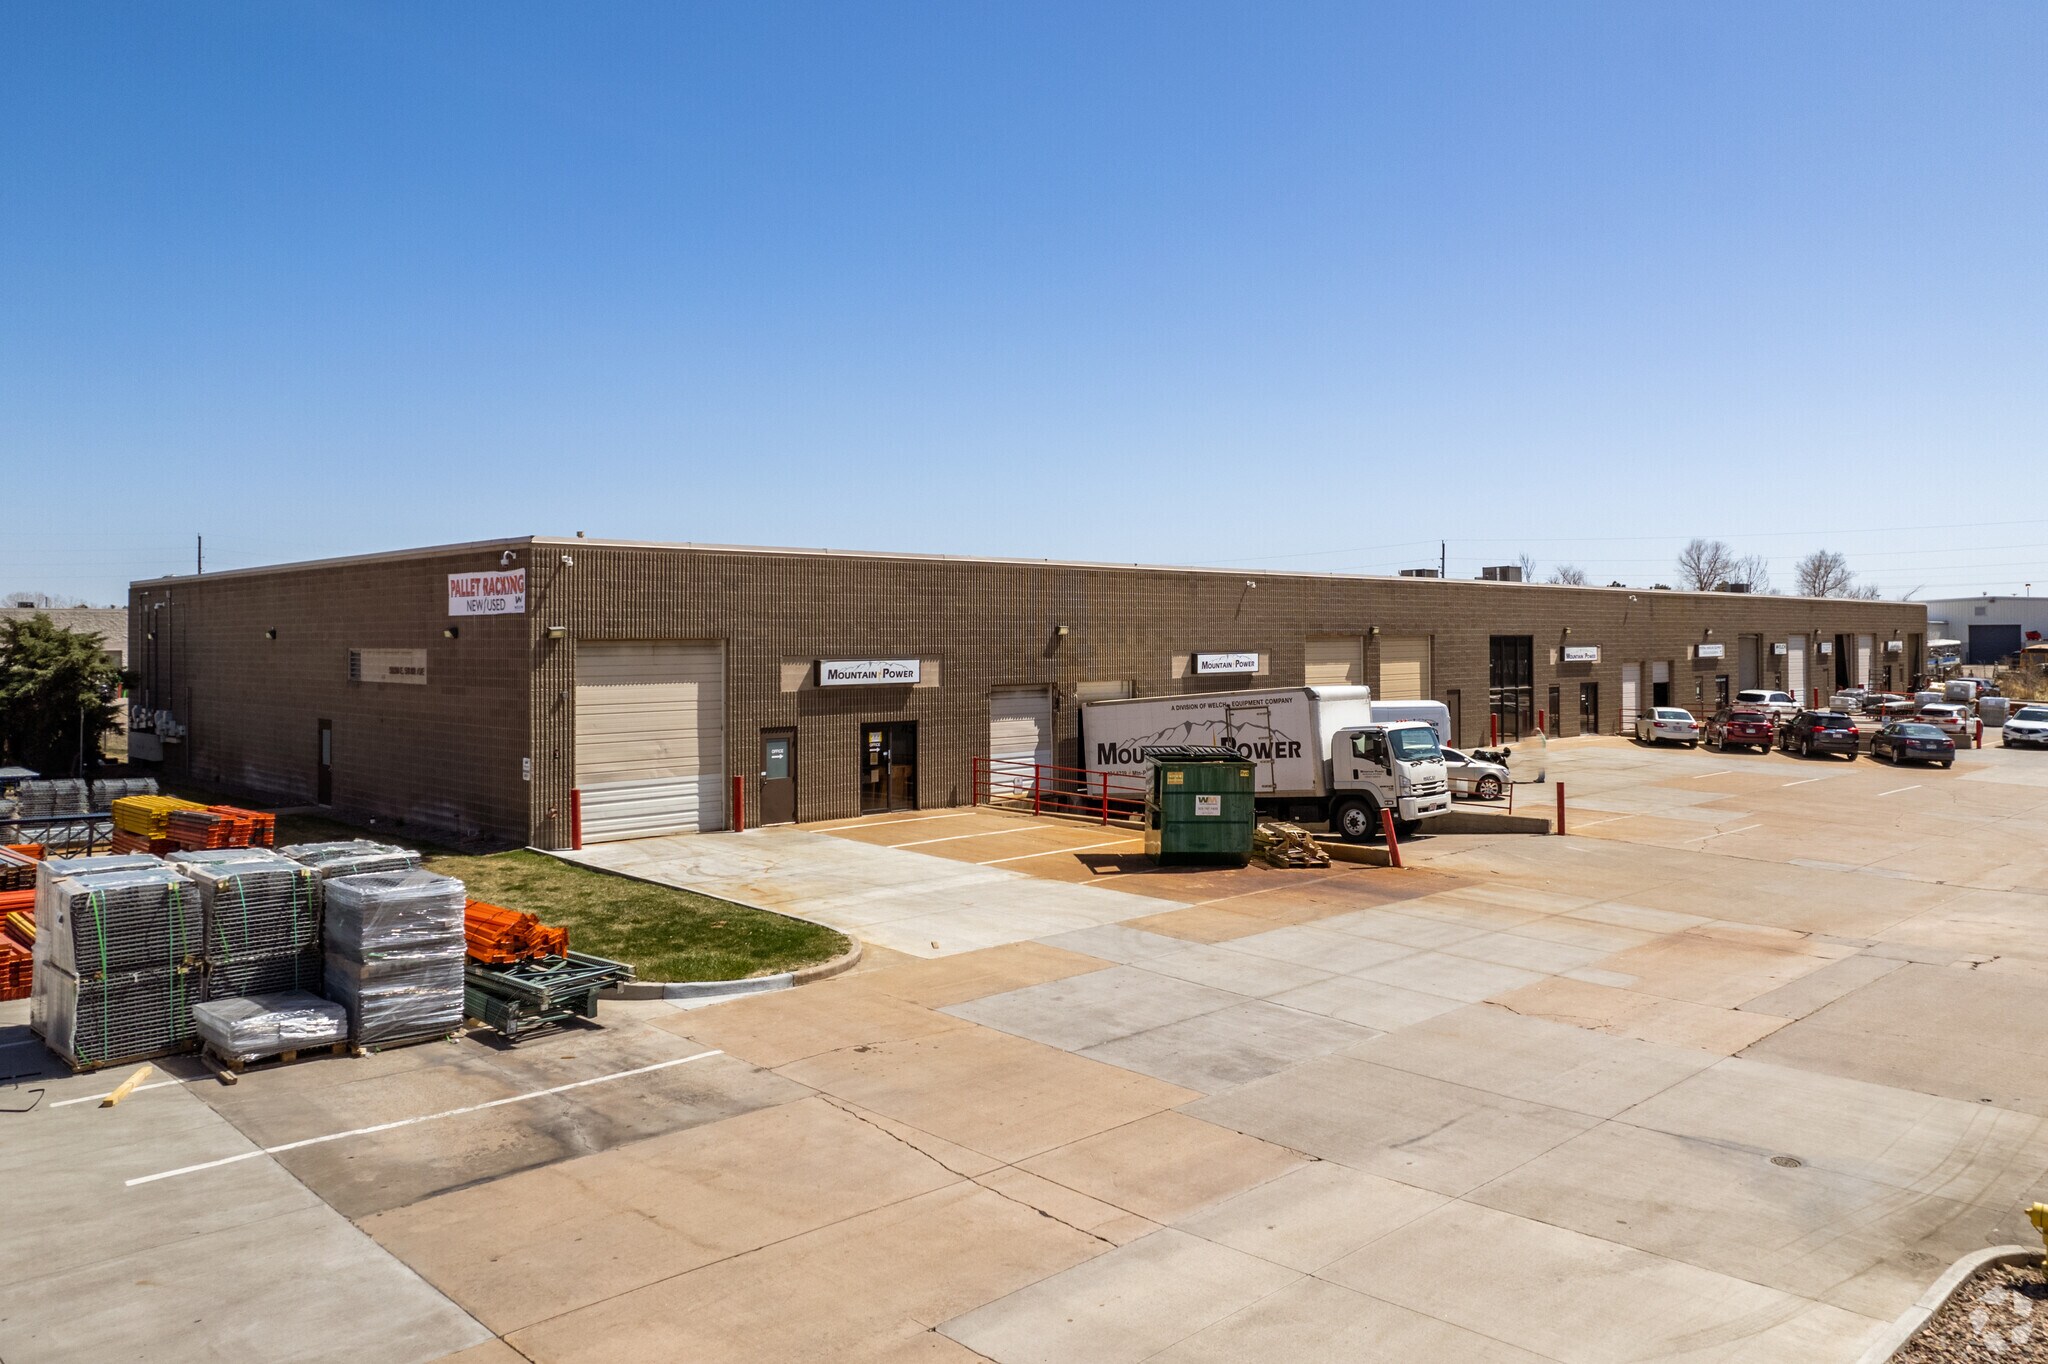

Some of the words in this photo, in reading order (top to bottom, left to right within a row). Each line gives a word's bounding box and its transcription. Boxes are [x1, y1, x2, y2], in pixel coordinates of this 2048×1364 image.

[450, 578, 480, 598] PALLET
[483, 575, 524, 596] RACKING
[466, 597, 506, 613] NEW/USED
[1201, 661, 1232, 669] MOUNTAIN
[1235, 660, 1255, 668] POWER
[827, 669, 877, 680] MOUNTAIN
[882, 668, 914, 679] POWER
[1231, 699, 1264, 707] EQUIPMENT
[1265, 697, 1293, 705] COMPANY
[1220, 737, 1302, 759] POWER
